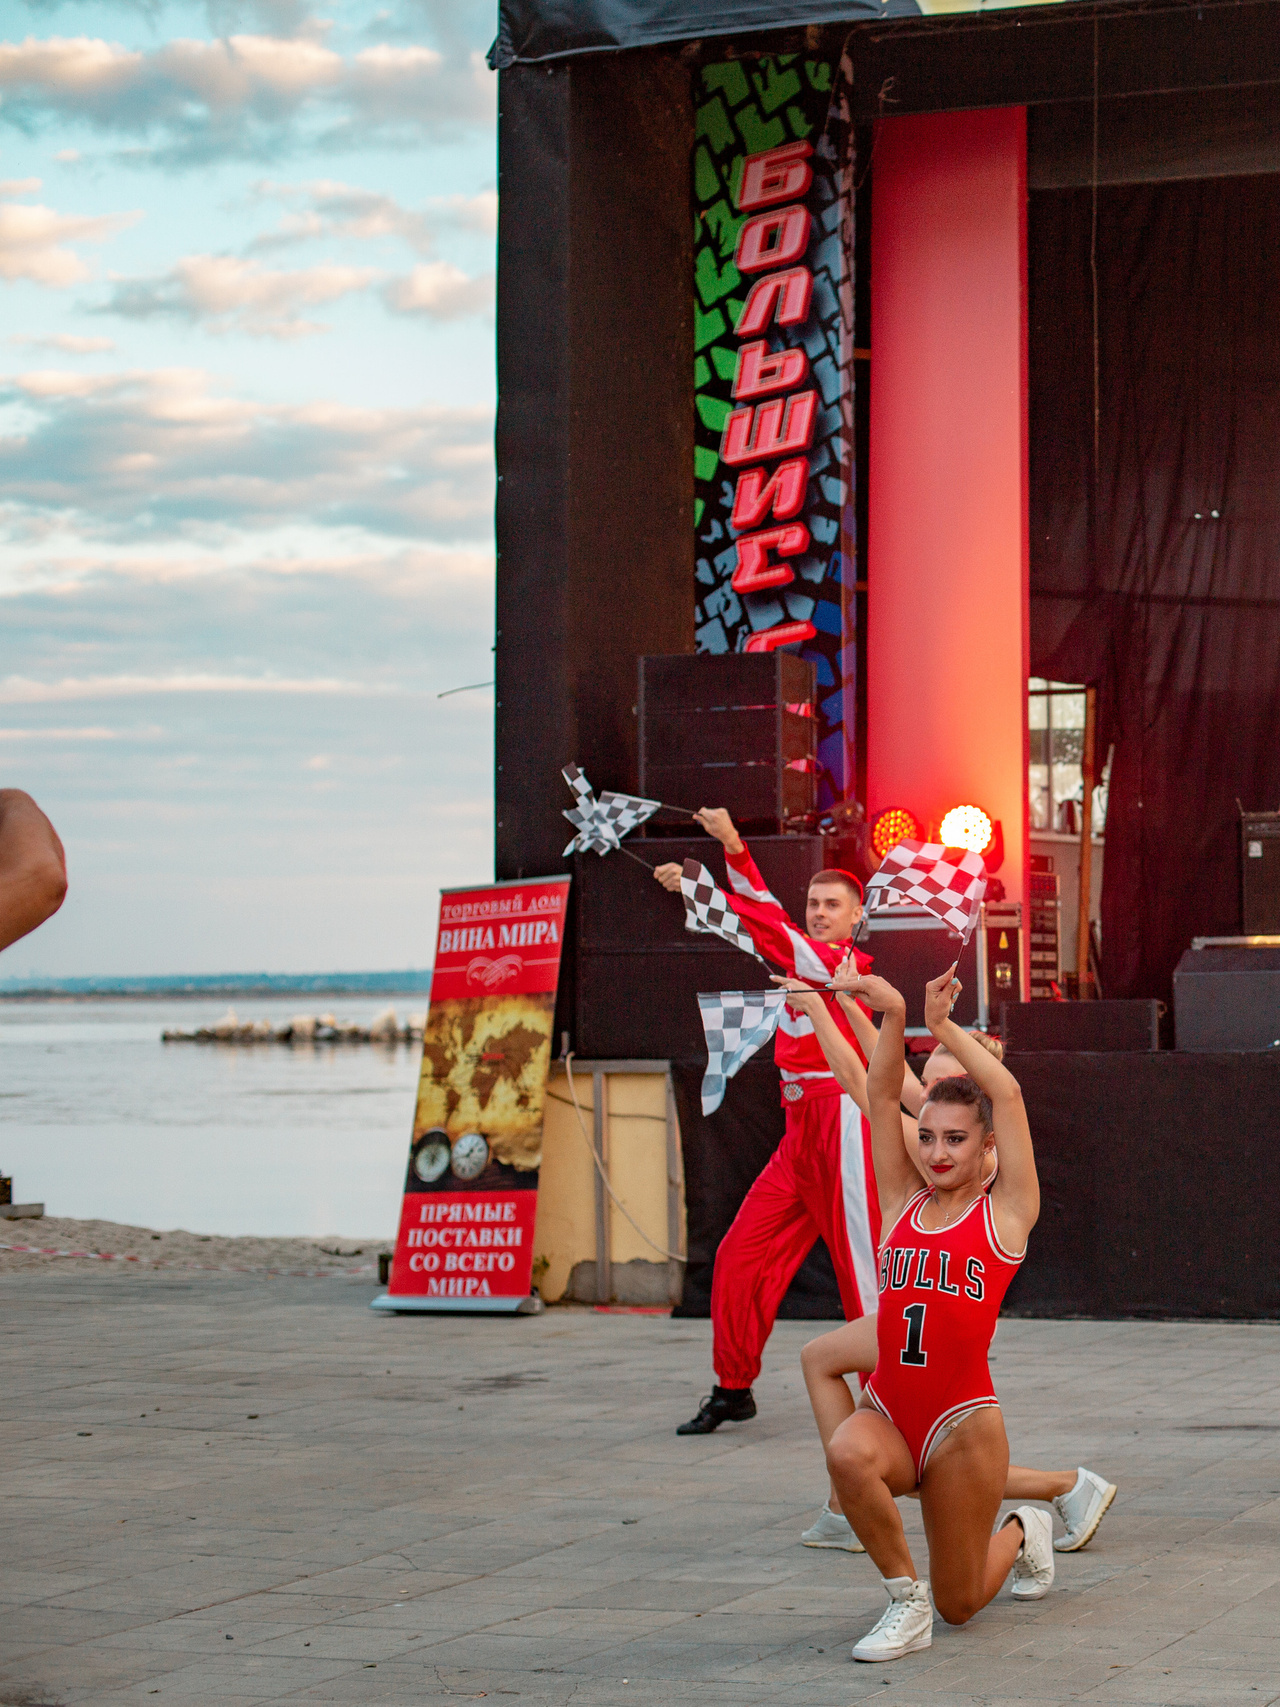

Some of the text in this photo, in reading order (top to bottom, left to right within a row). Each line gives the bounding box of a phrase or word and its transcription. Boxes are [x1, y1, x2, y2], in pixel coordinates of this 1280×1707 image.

[439, 920, 559, 954] ВИНА МИРА
[419, 1202, 517, 1223] ПРЯМЫЕ
[407, 1227, 523, 1248] ПОСТАВКИ
[409, 1252, 515, 1272] СО ВСЕГО
[879, 1247, 985, 1302] BULLS
[427, 1277, 492, 1297] МИРА
[900, 1303, 928, 1367] 1
